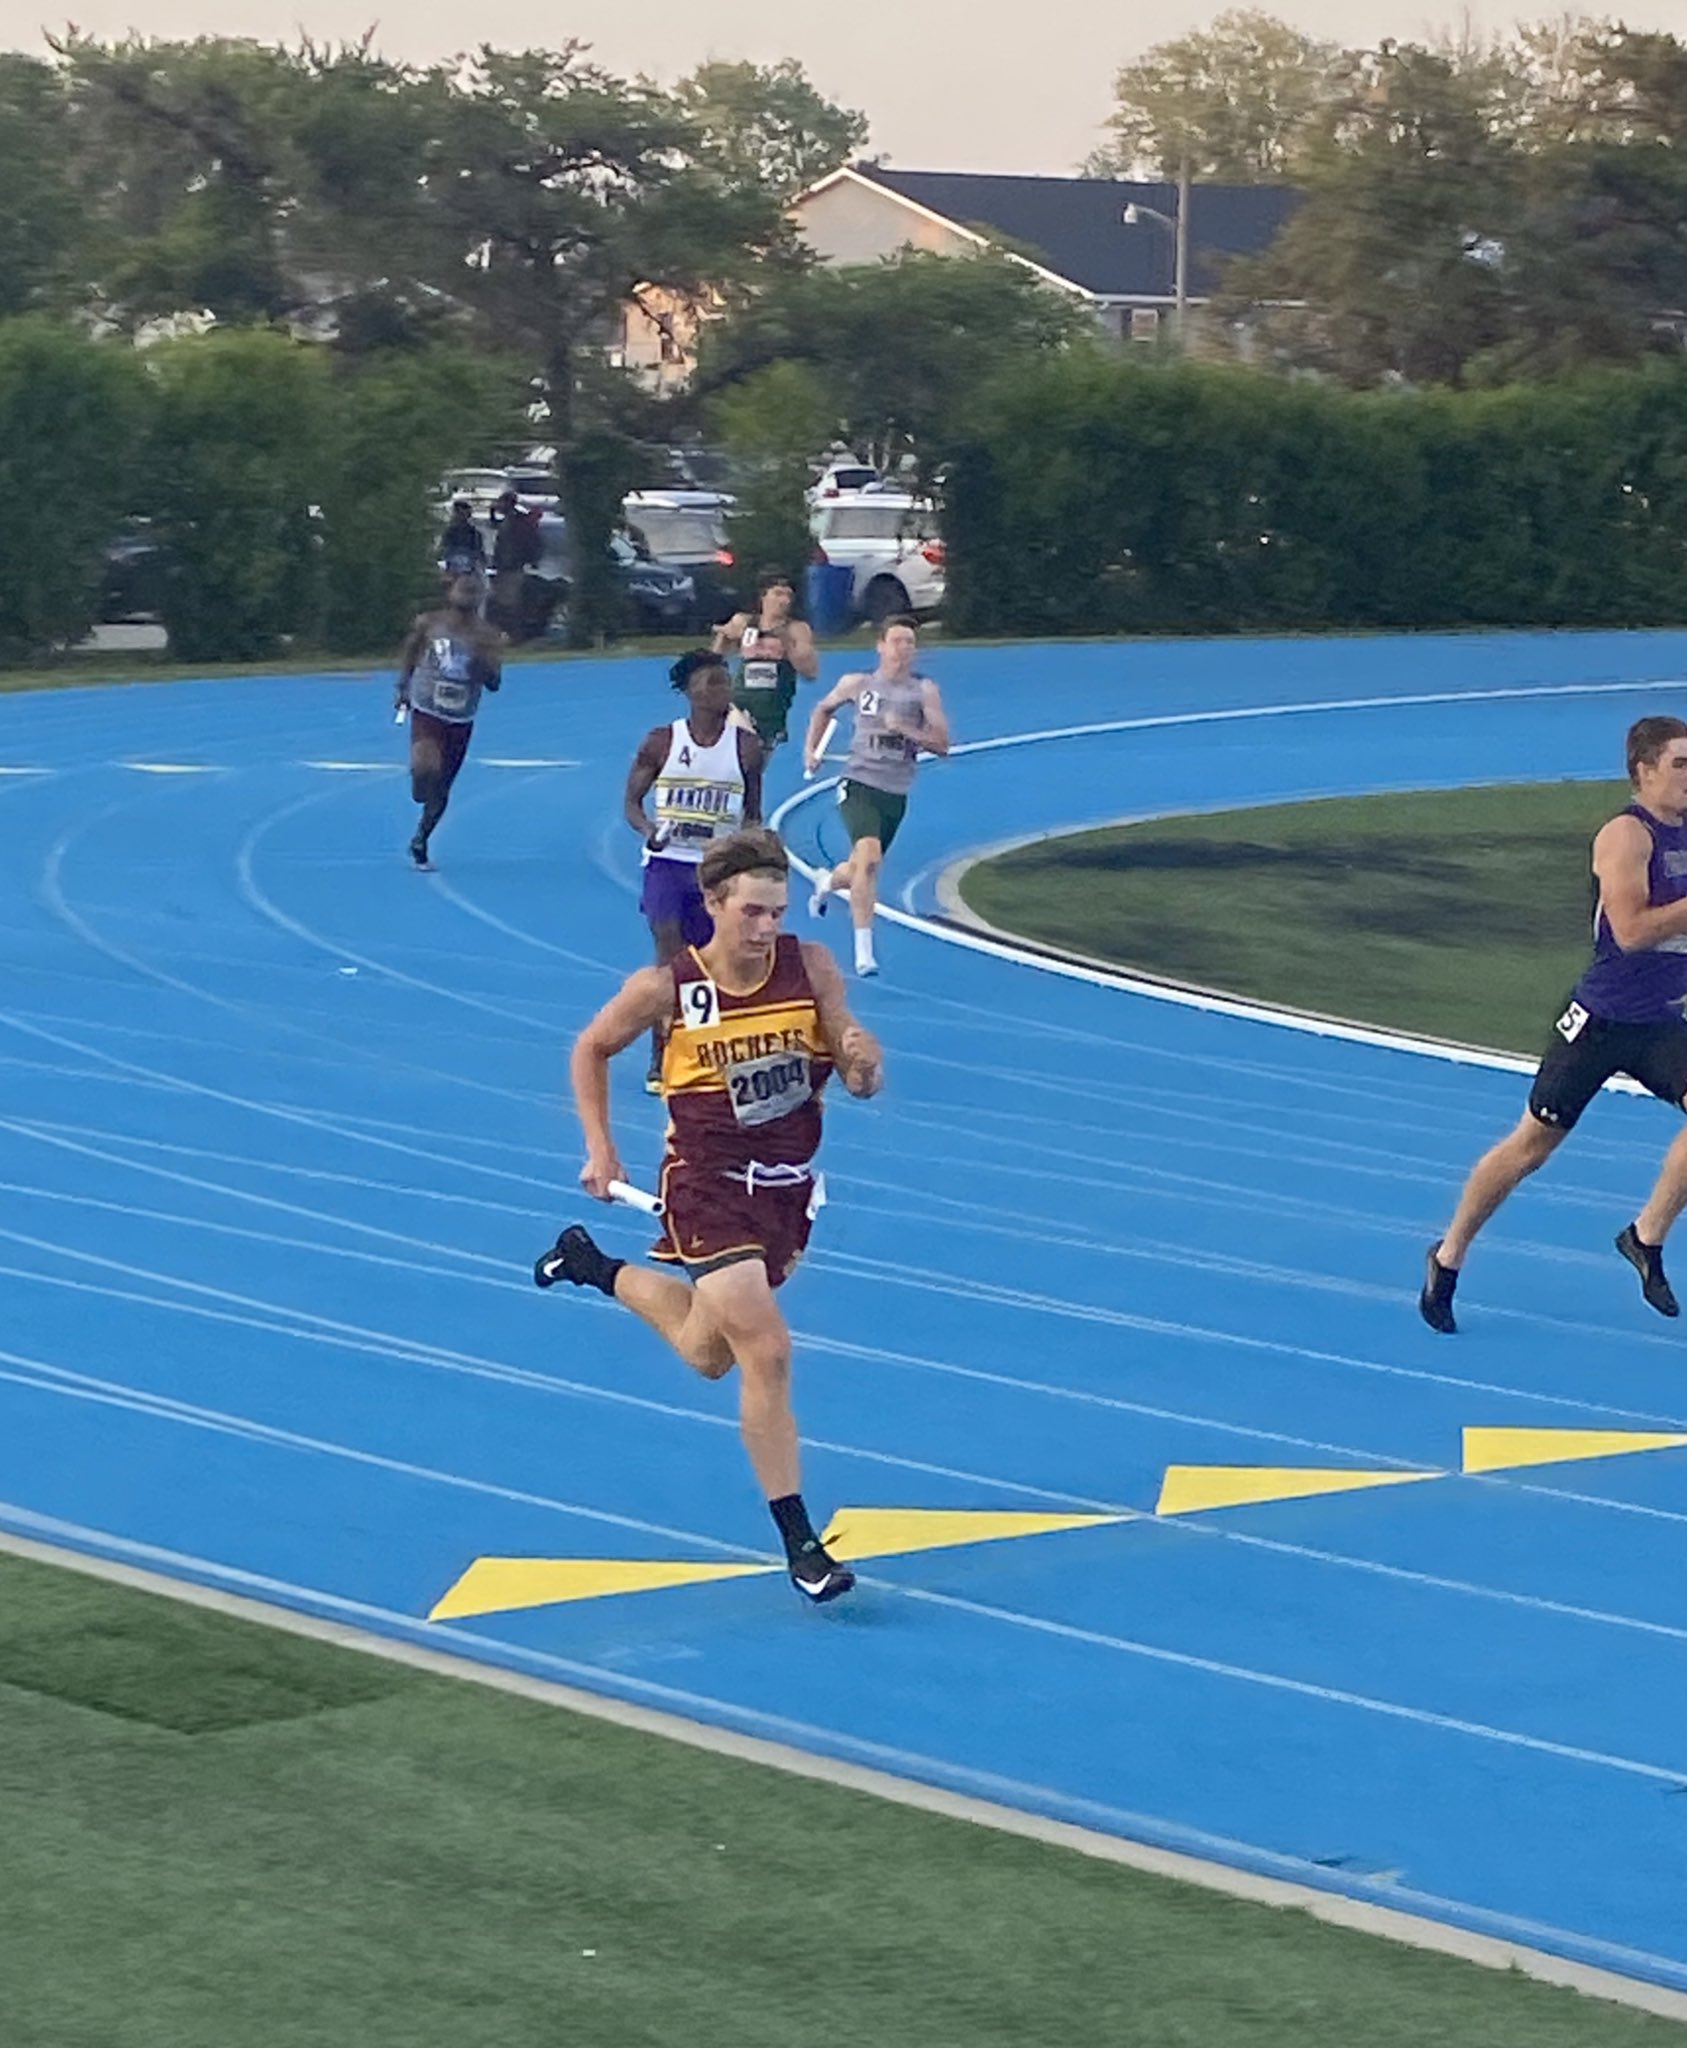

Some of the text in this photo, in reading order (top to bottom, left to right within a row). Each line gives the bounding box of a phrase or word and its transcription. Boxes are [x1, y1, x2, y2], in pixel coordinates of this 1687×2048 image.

[862, 690, 874, 711] 2
[678, 745, 691, 768] 4
[691, 984, 712, 1024] 9
[697, 1029, 804, 1067] ROCKETS
[731, 1057, 805, 1106] 2004
